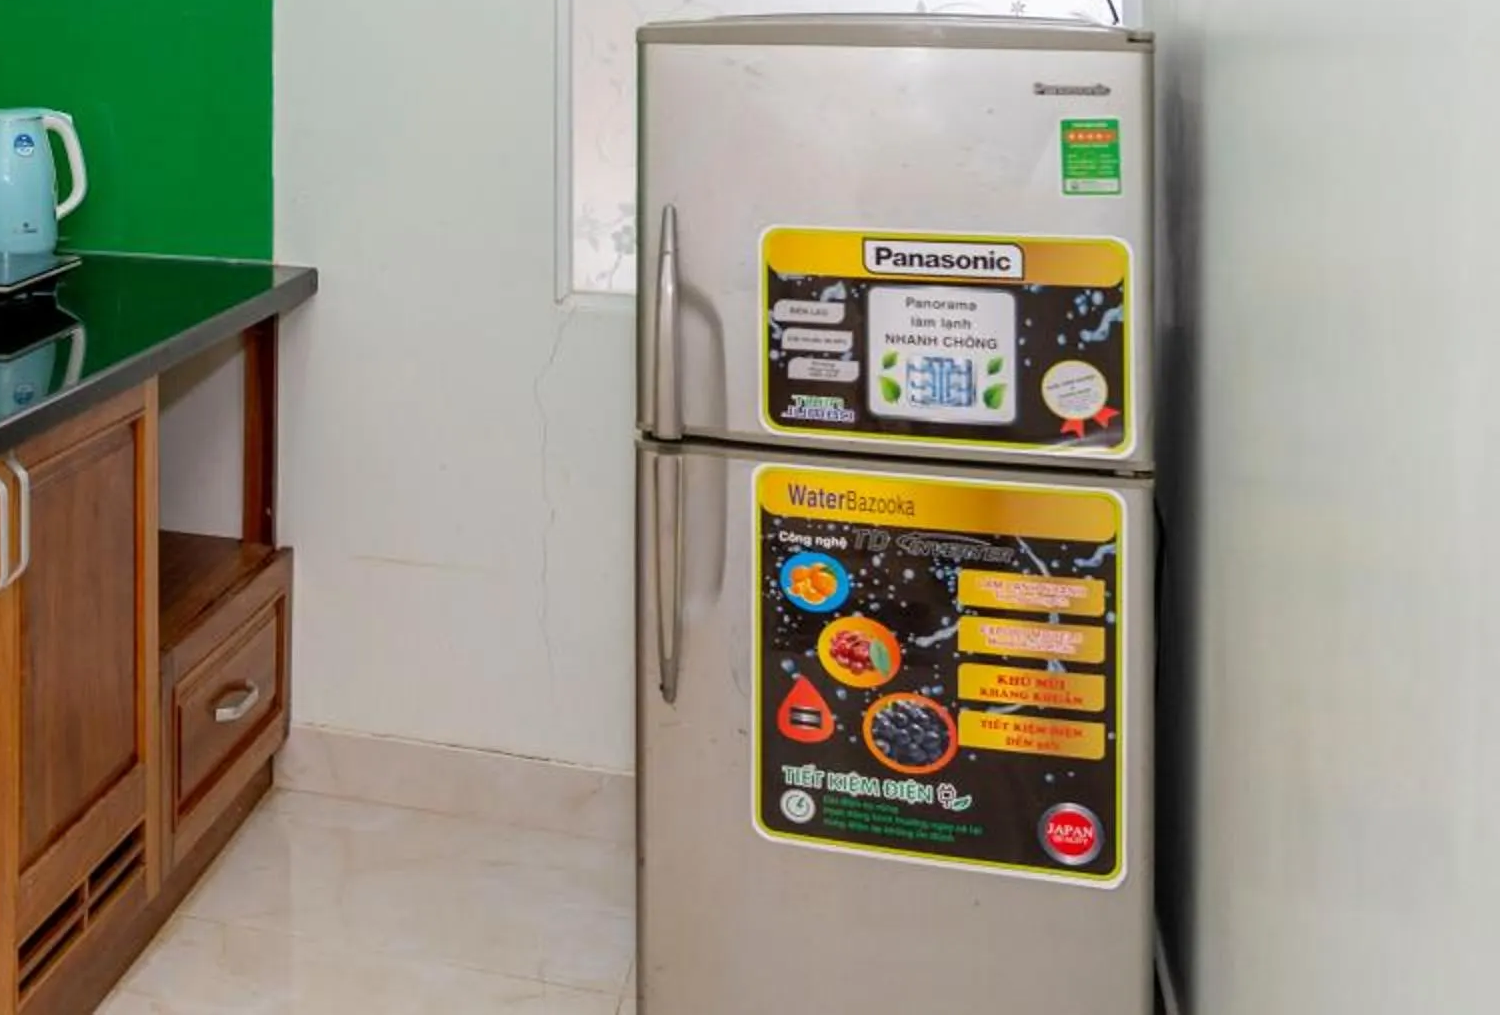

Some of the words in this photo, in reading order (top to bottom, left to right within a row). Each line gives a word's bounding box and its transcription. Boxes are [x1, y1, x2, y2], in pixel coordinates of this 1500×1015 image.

[875, 246, 1011, 271] Panasonic
[905, 296, 978, 312] Panorama
[884, 333, 937, 347] NHANH
[787, 483, 916, 516] WaterBazooka
[779, 530, 813, 546] Công
[827, 771, 880, 797] KIỆM
[1047, 822, 1093, 838] JAPAN
